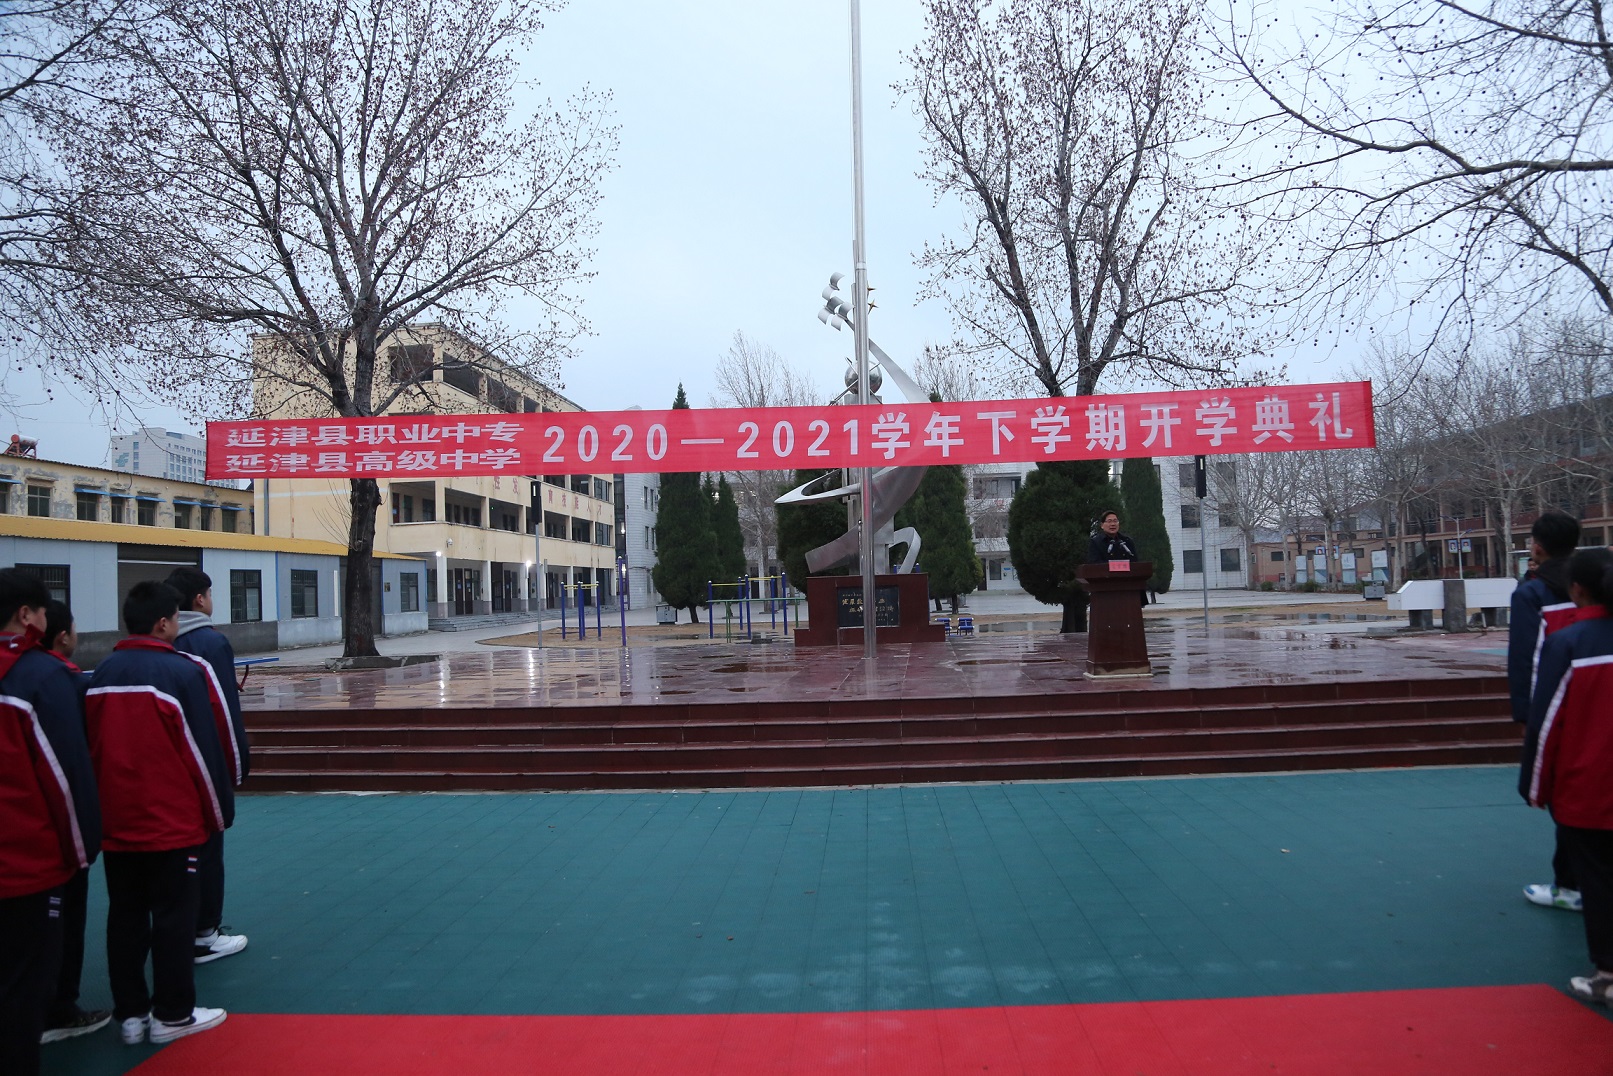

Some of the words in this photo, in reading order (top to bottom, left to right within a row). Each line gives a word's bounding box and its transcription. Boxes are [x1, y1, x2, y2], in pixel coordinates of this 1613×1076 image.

[225, 421, 524, 447] 延津县职业中专
[225, 448, 521, 473] 延津县高级中学
